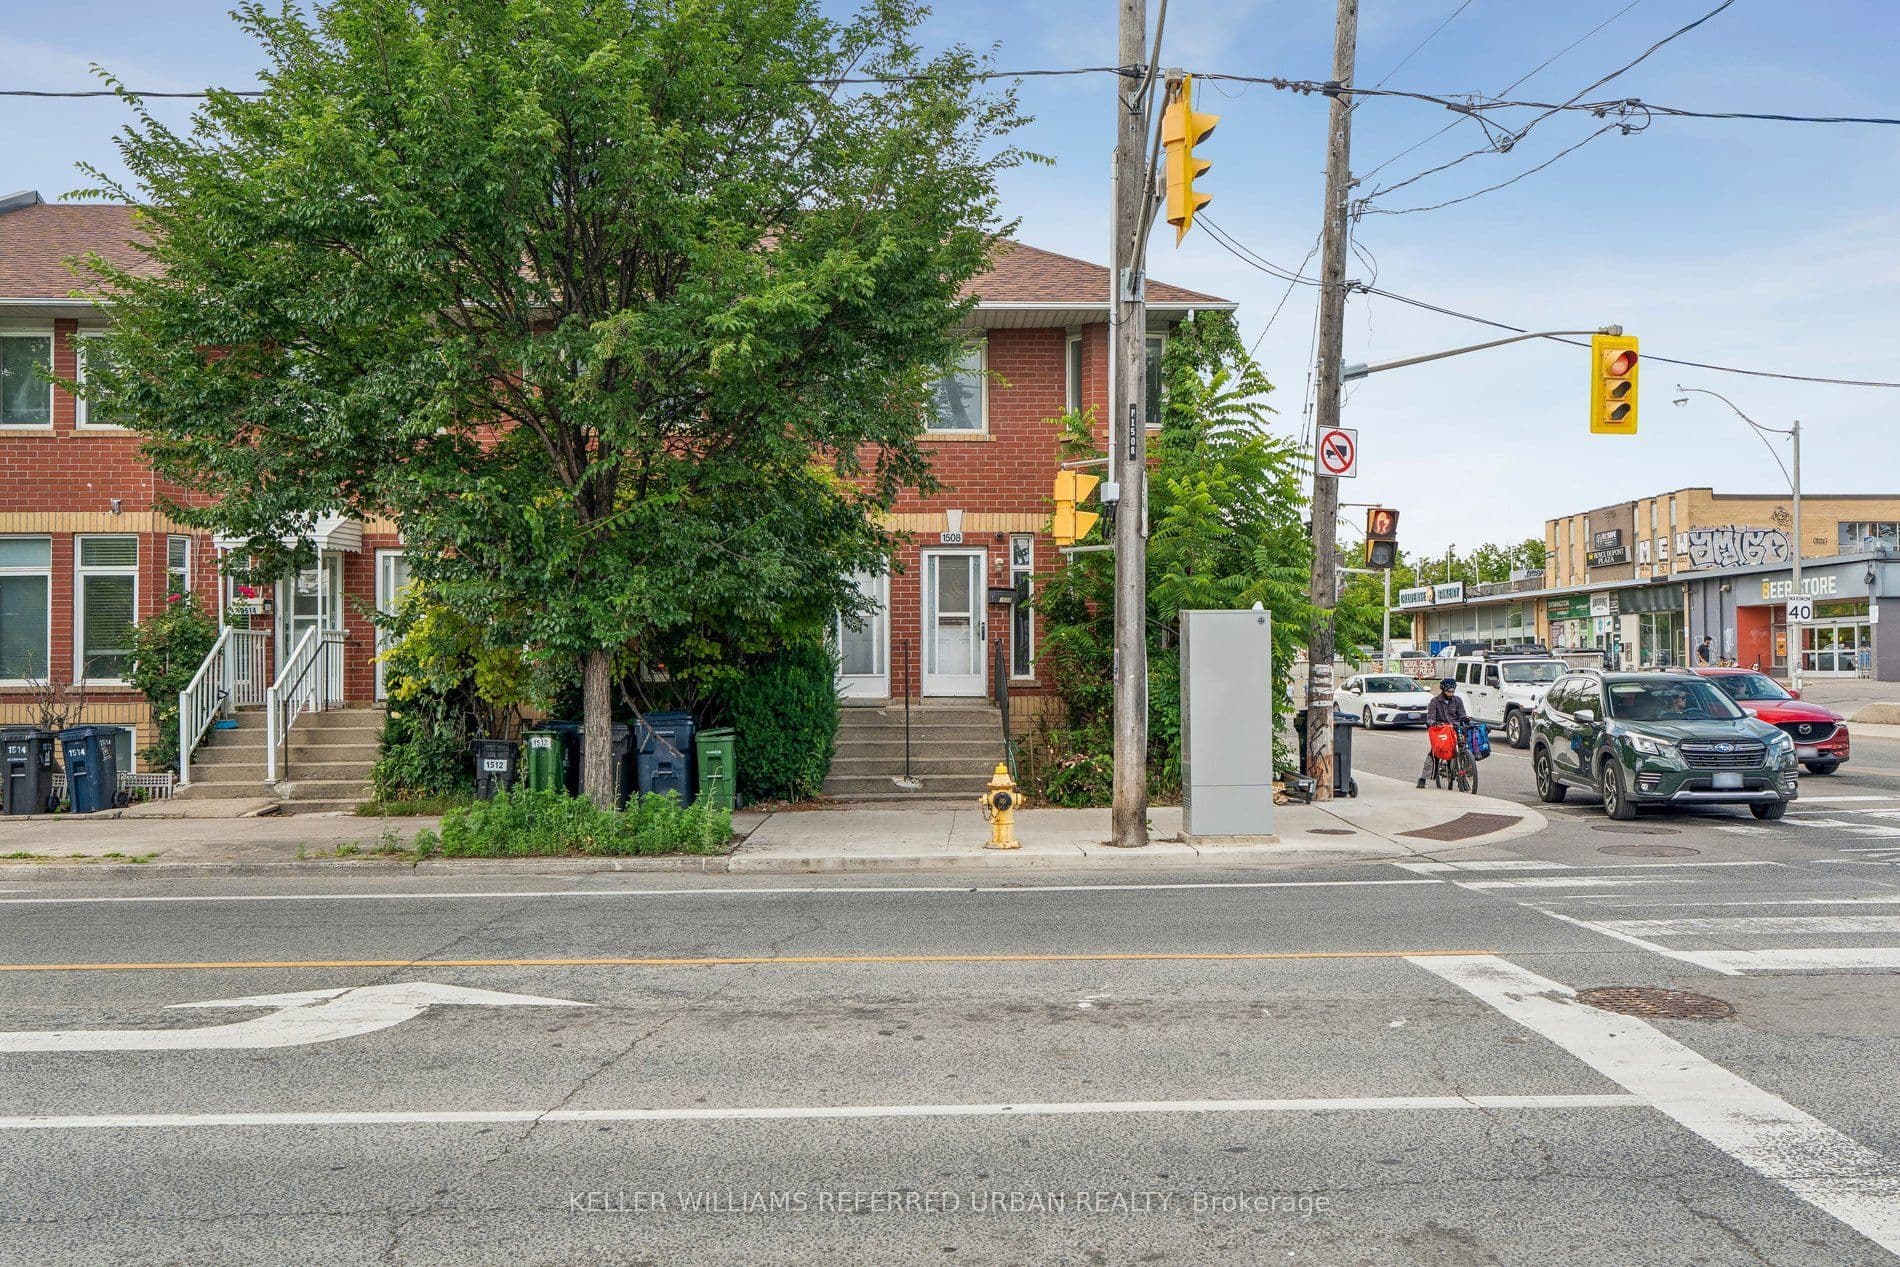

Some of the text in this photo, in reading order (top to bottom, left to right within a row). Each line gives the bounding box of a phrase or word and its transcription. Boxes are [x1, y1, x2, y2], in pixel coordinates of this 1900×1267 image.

[942, 533, 961, 542] 1508
[1598, 557, 1615, 565] PLAZA
[1801, 575, 1837, 596] TORE
[1788, 605, 1811, 619] 40
[8, 746, 27, 754] 1514
[68, 748, 86, 757] 1514
